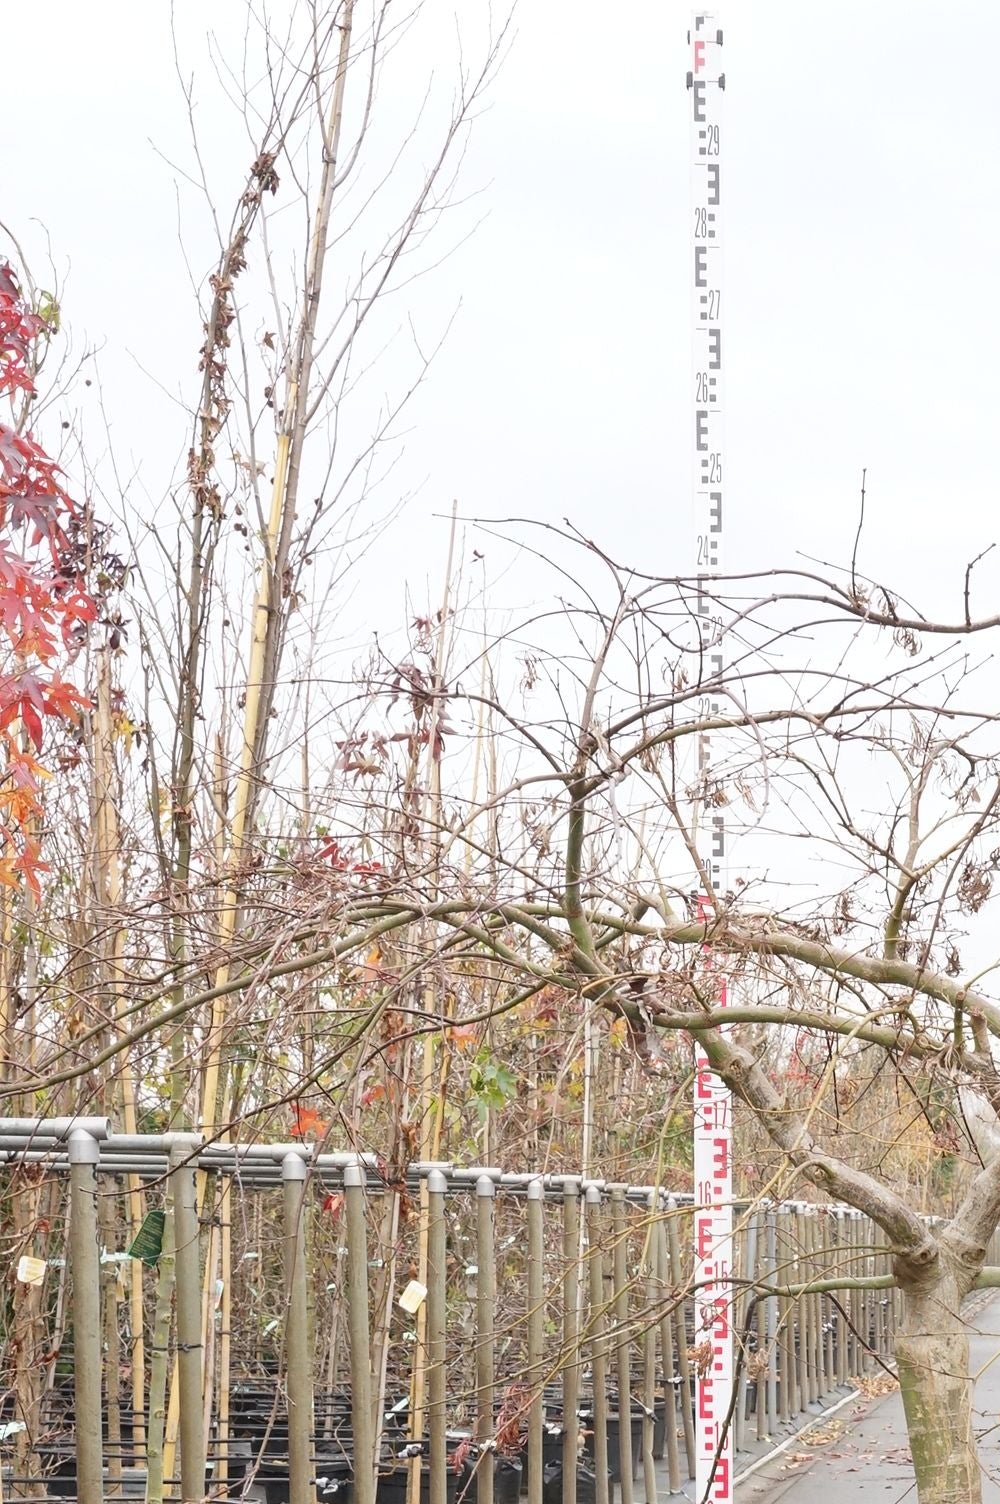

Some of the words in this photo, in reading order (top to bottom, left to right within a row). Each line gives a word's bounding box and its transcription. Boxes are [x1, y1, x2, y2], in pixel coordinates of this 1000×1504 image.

[707, 124, 720, 156] 29
[694, 207, 707, 238] 28
[708, 289, 721, 321] 27
[696, 372, 708, 403] 26
[710, 453, 722, 484] 25
[697, 535, 709, 566] 24
[714, 1099, 727, 1130] 17
[698, 1181, 712, 1211] 16
